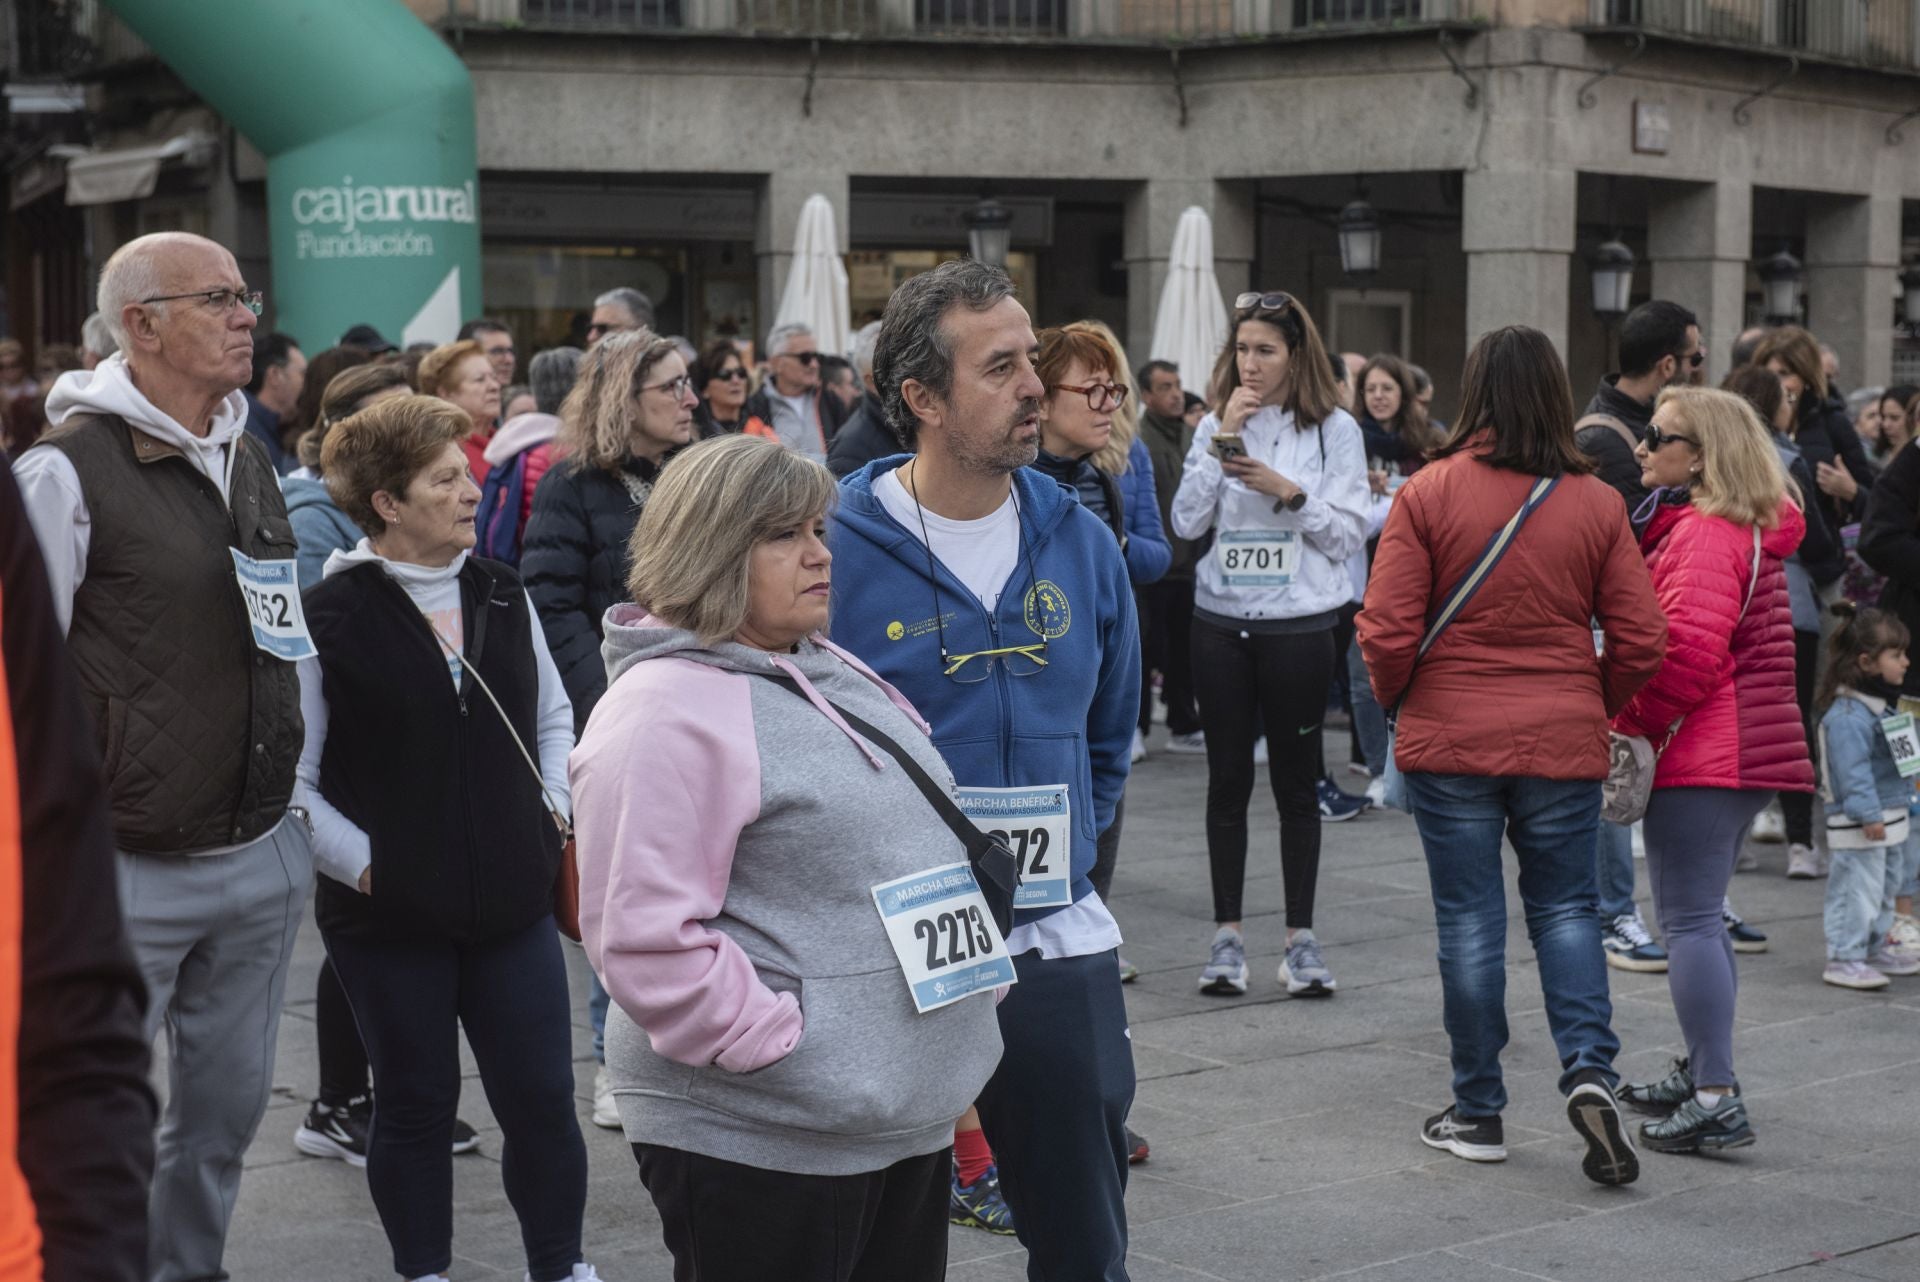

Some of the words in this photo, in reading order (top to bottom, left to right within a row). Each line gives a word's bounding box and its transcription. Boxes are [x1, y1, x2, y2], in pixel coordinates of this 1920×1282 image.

[296, 228, 434, 259] Fundación
[1226, 548, 1283, 569] 8701
[960, 805, 1060, 817] SEGOVIADAUNPASOSOLIDARIO
[1010, 793, 1056, 808] BENÉFICA
[988, 827, 1050, 875] 72
[896, 880, 942, 901] MARCHA
[914, 904, 993, 971] 2273
